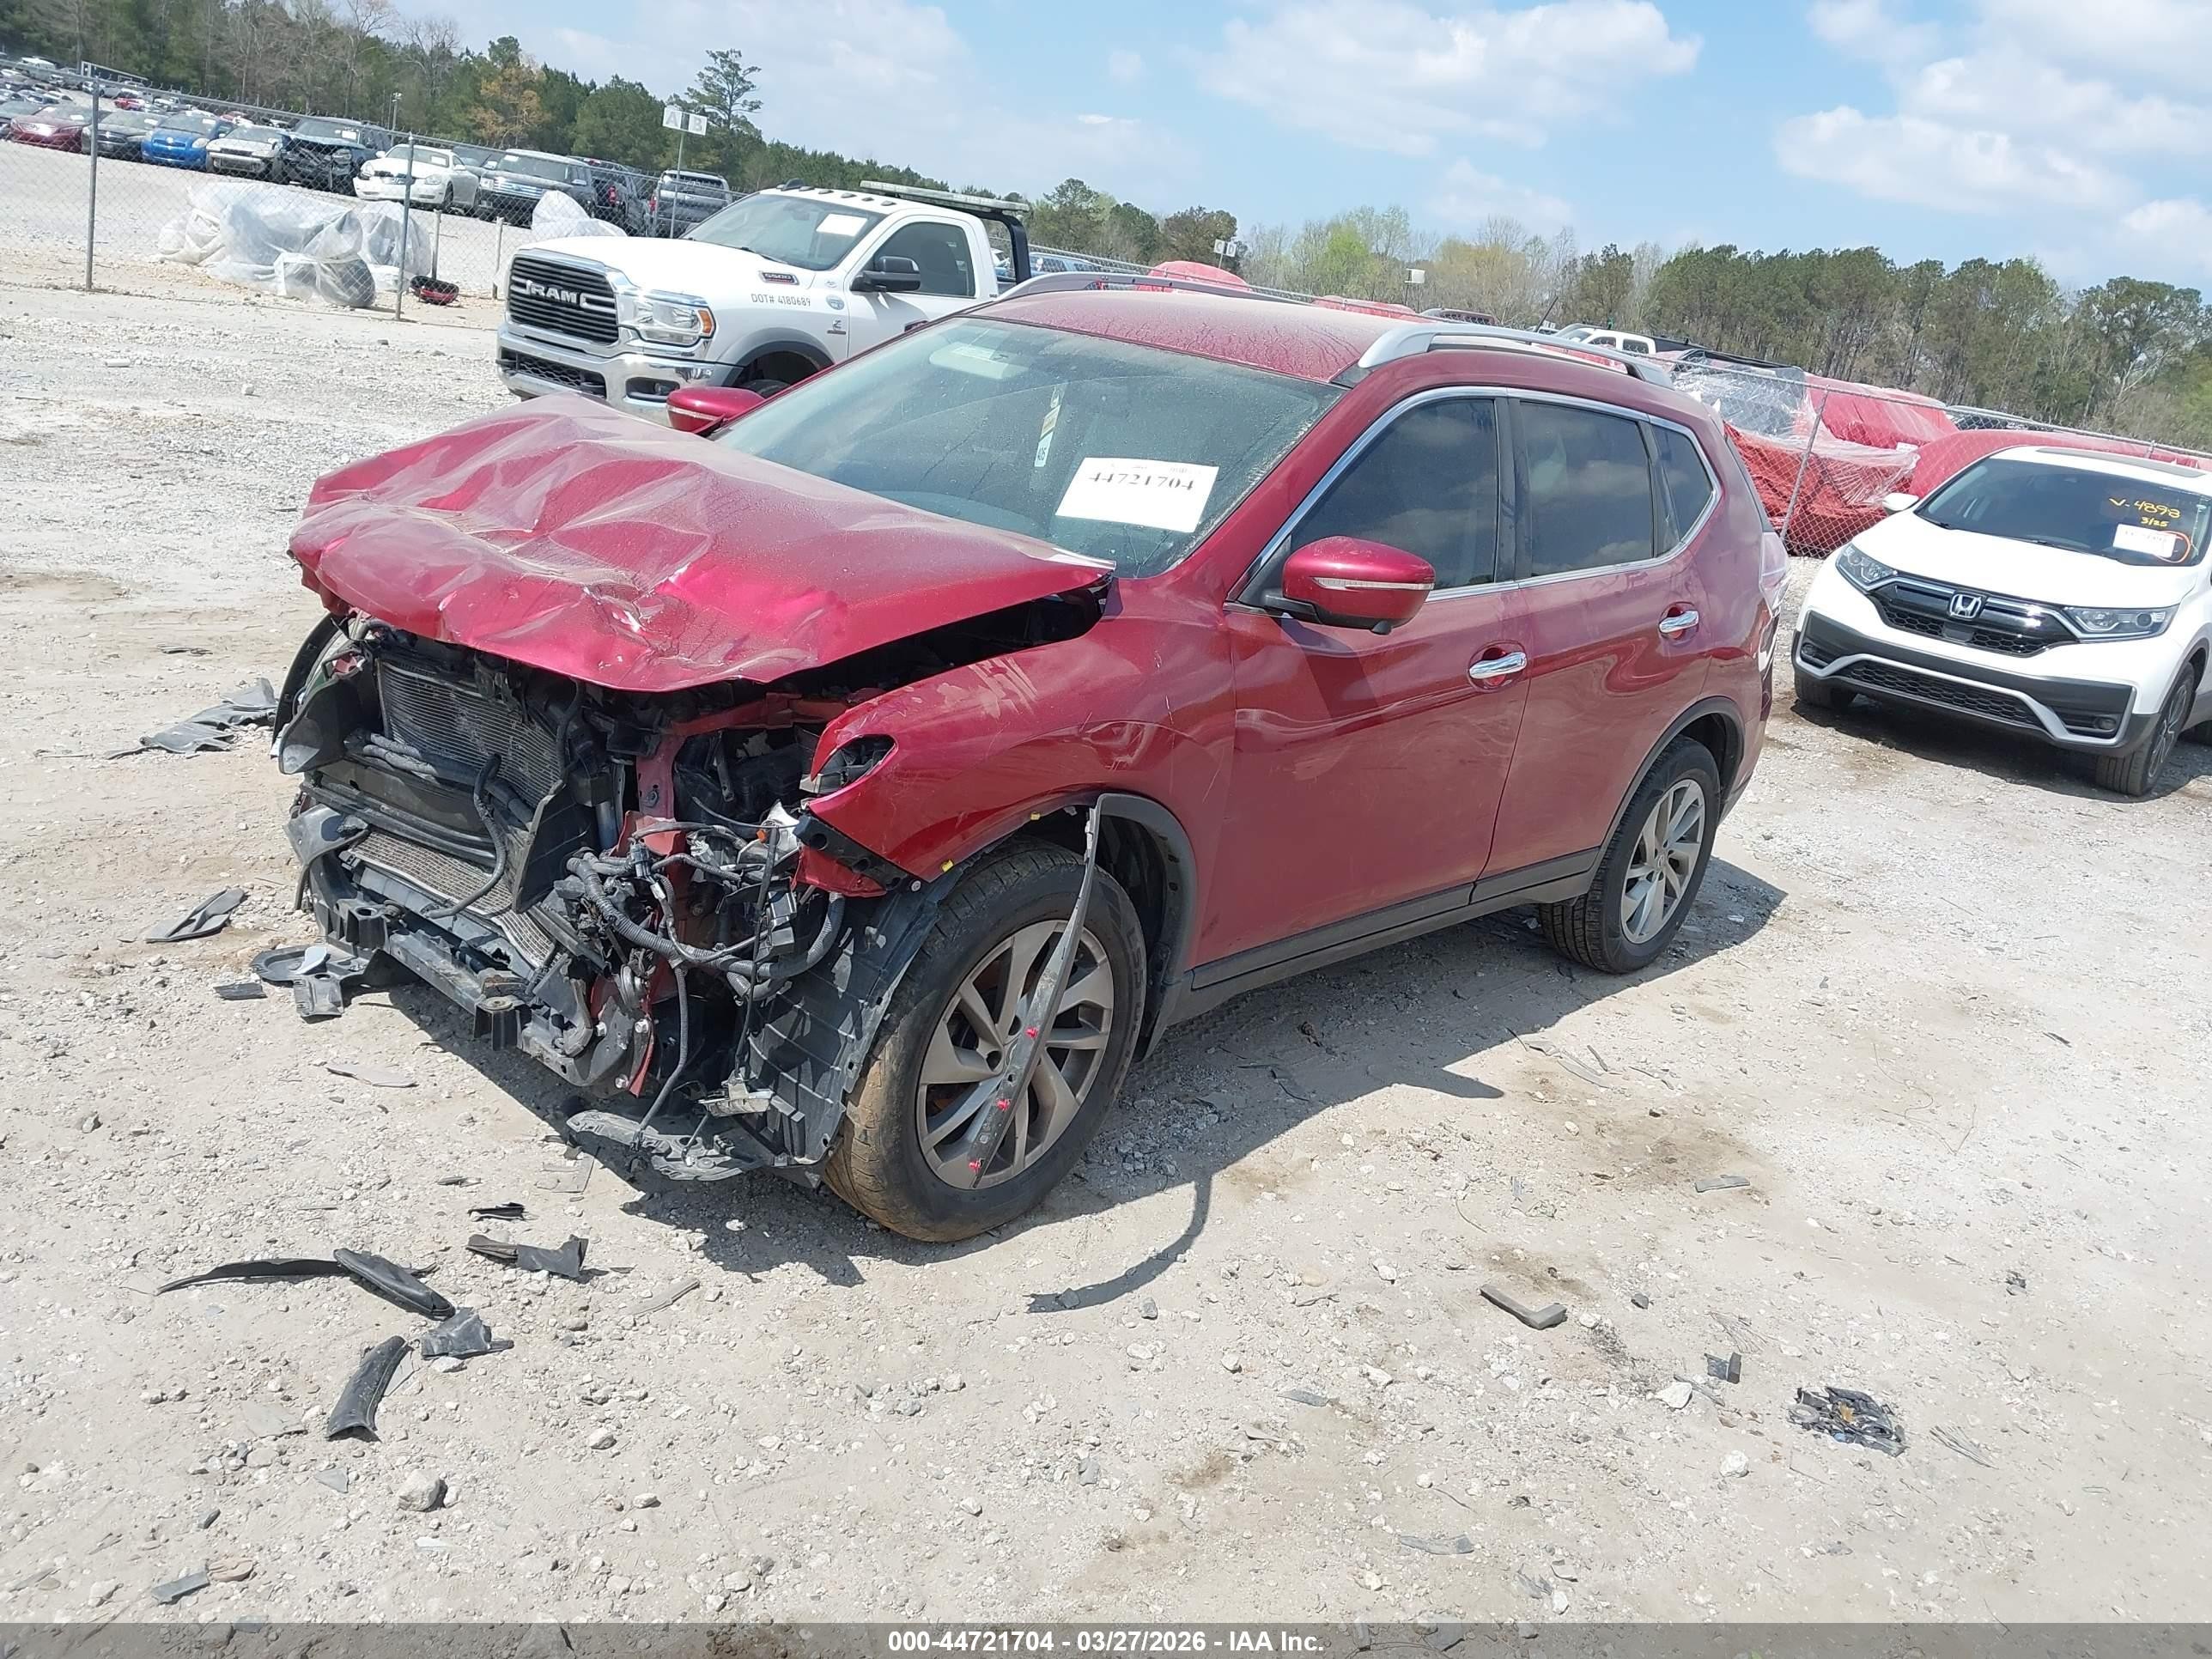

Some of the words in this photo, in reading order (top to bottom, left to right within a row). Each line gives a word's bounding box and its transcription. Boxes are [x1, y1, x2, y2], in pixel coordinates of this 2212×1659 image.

[665, 111, 680, 127] A
[692, 114, 702, 131] B
[530, 283, 578, 304] RAM
[750, 293, 775, 304] DOT#
[1089, 472, 1194, 490] 44721704
